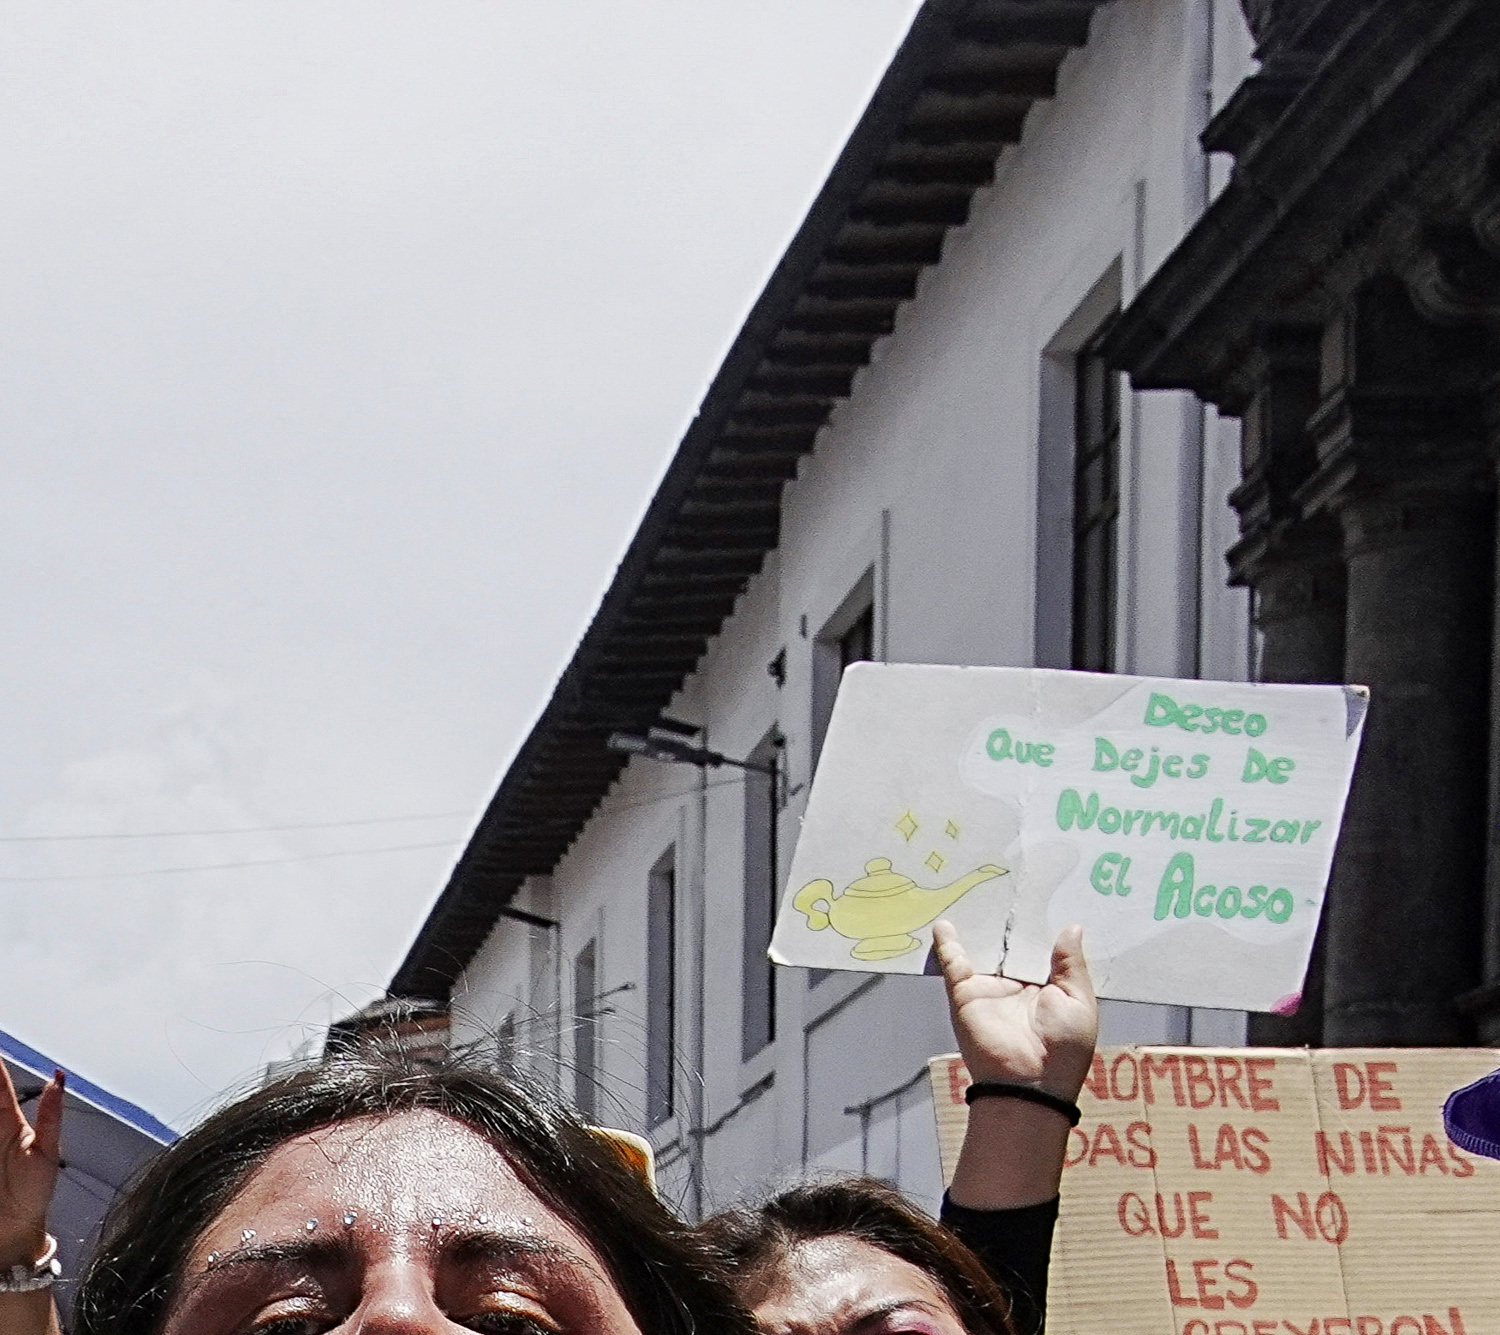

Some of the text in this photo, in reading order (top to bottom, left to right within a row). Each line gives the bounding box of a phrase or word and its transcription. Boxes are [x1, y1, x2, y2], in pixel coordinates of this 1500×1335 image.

[985, 728, 1297, 789] Que Dejes De
[1055, 788, 1324, 844] Normalizar
[1090, 851, 1295, 925] El Acoso
[1335, 1061, 1403, 1112] DE
[1188, 1122, 1273, 1175] LAS
[1315, 1125, 1476, 1179] NIÑAS
[1117, 1190, 1350, 1245] QUE NO
[1166, 1258, 1259, 1310] LES
